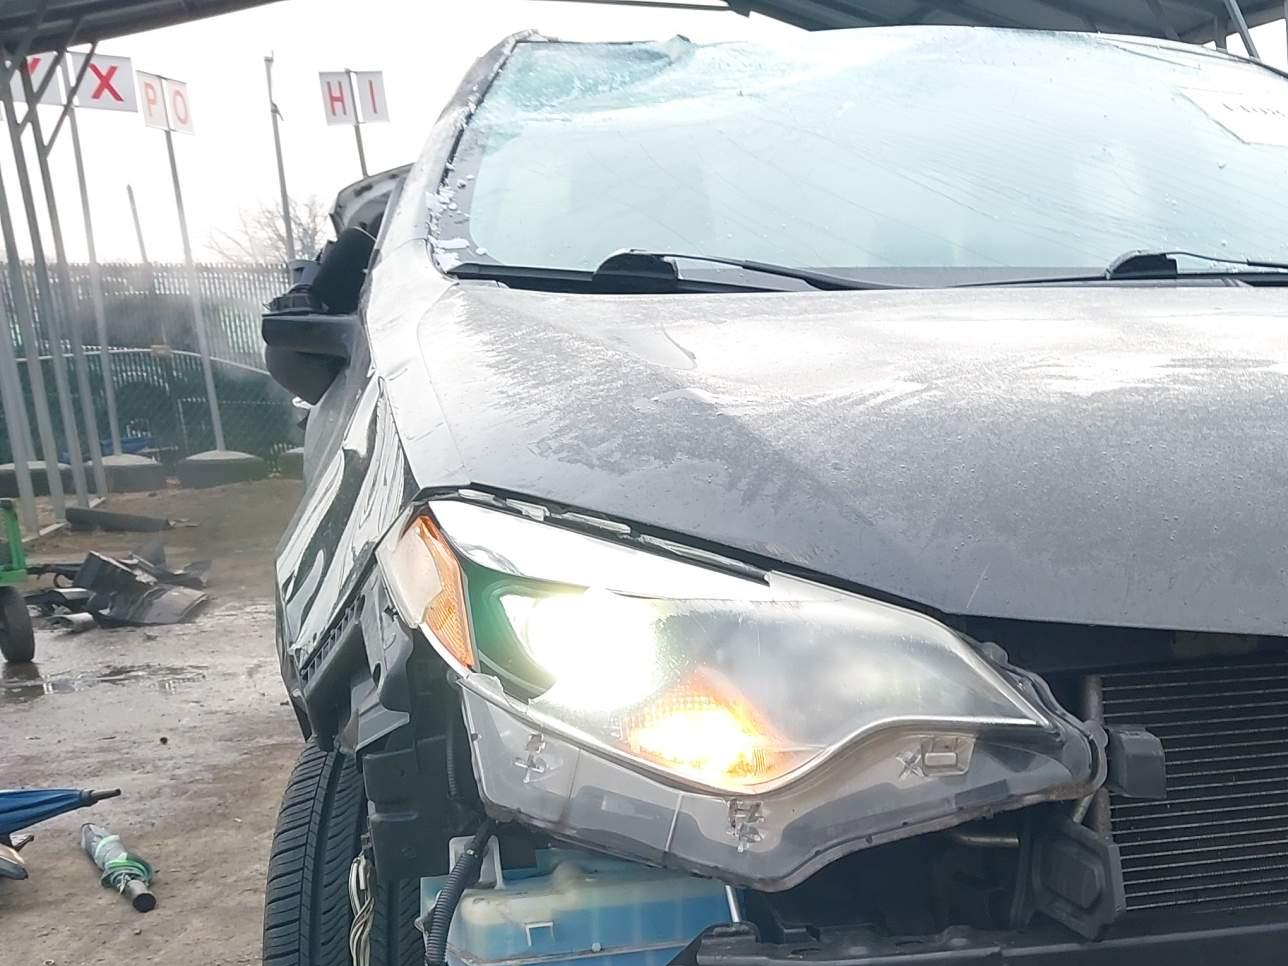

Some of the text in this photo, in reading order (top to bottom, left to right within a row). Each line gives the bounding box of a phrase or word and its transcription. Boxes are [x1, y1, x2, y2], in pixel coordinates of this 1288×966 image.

[86, 63, 124, 102] X
[144, 81, 157, 117] P
[326, 80, 347, 116] H
[367, 79, 378, 114] I
